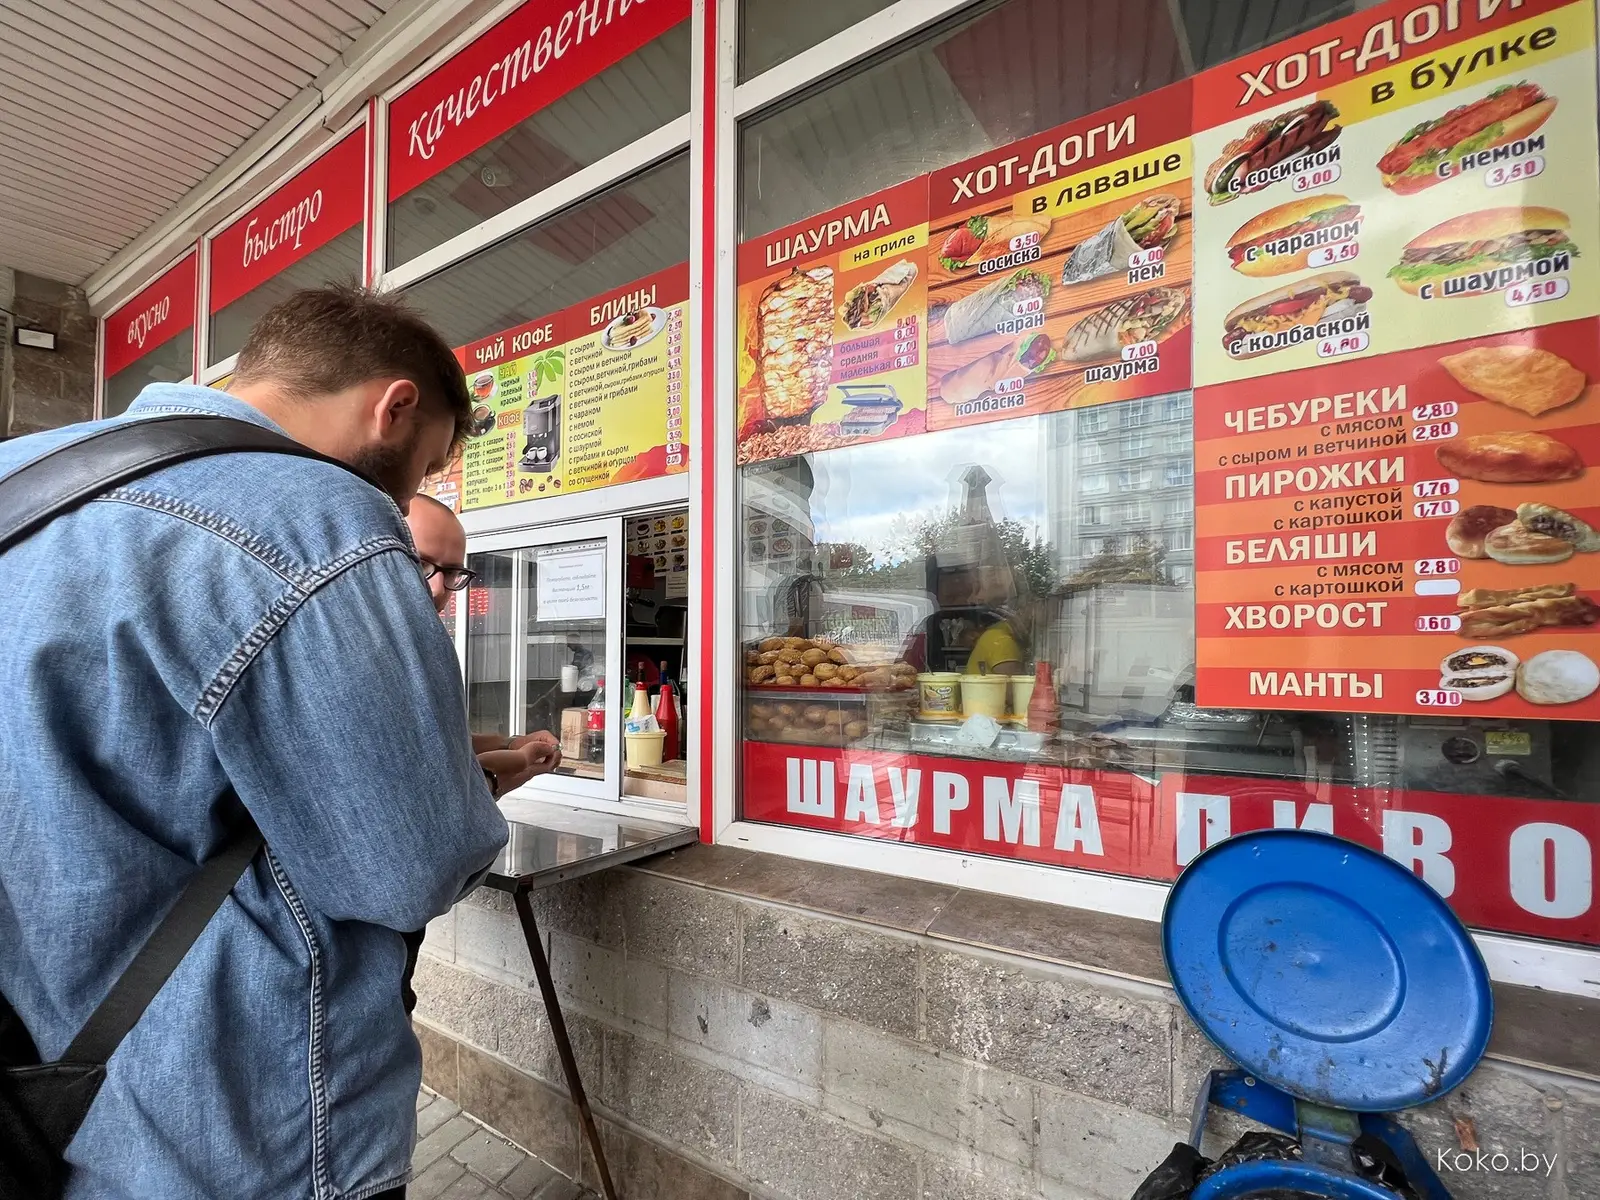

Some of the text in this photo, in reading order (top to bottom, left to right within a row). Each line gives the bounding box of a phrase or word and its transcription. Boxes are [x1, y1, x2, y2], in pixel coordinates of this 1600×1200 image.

[1371, 25, 1557, 105] в булке
[952, 114, 1137, 205] ХОТ-ДОГИ
[1438, 134, 1546, 177] с немом
[1228, 146, 1341, 193] с сосиской
[1492, 161, 1536, 187] 3,50
[1032, 153, 1181, 214] в лаваше
[1297, 170, 1332, 191] 3,00
[243, 189, 322, 267] быстро
[766, 203, 892, 268] ШАУРМА
[854, 233, 916, 262] на гриле
[1015, 233, 1039, 251] 3,50
[1246, 218, 1360, 262] с чараном
[979, 246, 1041, 274] сосиска
[1132, 248, 1164, 266] 4,00
[1323, 241, 1359, 264] 3,50
[1129, 263, 1165, 283] нем
[1420, 251, 1571, 300] с шаурмой
[1511, 281, 1557, 304] 4,50
[590, 284, 657, 327] БЛИНЫ
[1016, 300, 1040, 315] 4,00
[127, 296, 169, 349] вкусно
[996, 313, 1044, 334] чаран
[1229, 311, 1371, 355] с колбаской
[476, 323, 553, 364] ЧАЙ КОФЕ
[574, 341, 595, 355] сыром
[840, 337, 880, 354] большая
[1127, 343, 1155, 361] 7,00
[574, 348, 603, 364] ветчиной
[574, 364, 595, 377] сыром
[601, 350, 632, 367] ветчиной
[840, 351, 879, 368] средняя
[500, 362, 517, 379] ЧАЙ
[840, 361, 891, 380] маленькая
[1085, 358, 1158, 382] шаурма
[500, 376, 520, 388] черный
[500, 385, 522, 397] зеленый
[998, 378, 1023, 394] 4,00
[500, 394, 522, 407] красный
[574, 393, 603, 409] ветчиной
[609, 385, 638, 401] грибами
[956, 394, 1024, 415] колбаска
[498, 412, 520, 426] КОФЕ
[574, 406, 601, 419] чараном
[1224, 384, 1407, 434] ЧЕБУРЕКИ
[1416, 402, 1453, 419] 2,80
[573, 419, 595, 430] немом
[573, 427, 602, 441] сосиской
[1320, 415, 1403, 437] с мясом
[1416, 422, 1452, 441] 2,80
[573, 439, 602, 453] шаурмой
[573, 450, 600, 464] грибами
[606, 445, 629, 459] сыром
[1218, 430, 1407, 468] с сыром и ветчиной
[573, 460, 602, 475] ветчиной
[1225, 456, 1405, 499] ПИРОЖКИ
[577, 471, 610, 486] сгущенкой
[1416, 482, 1451, 498] 1,70
[1294, 488, 1402, 514] с капустой
[1416, 501, 1452, 518] 1,70
[1273, 507, 1403, 532] с картошкой
[1226, 530, 1377, 565] БЕЛЯШИ
[1316, 561, 1403, 578] с мясом
[1419, 560, 1459, 575] 2,80
[1274, 577, 1403, 598] с картошкой
[1224, 601, 1389, 630] ХВОРОСТ
[1416, 616, 1451, 631] 0,60
[1249, 671, 1384, 699] МАНТЫ
[1419, 691, 1459, 705] 3,00
[786, 757, 1104, 857] ШАУРМА
